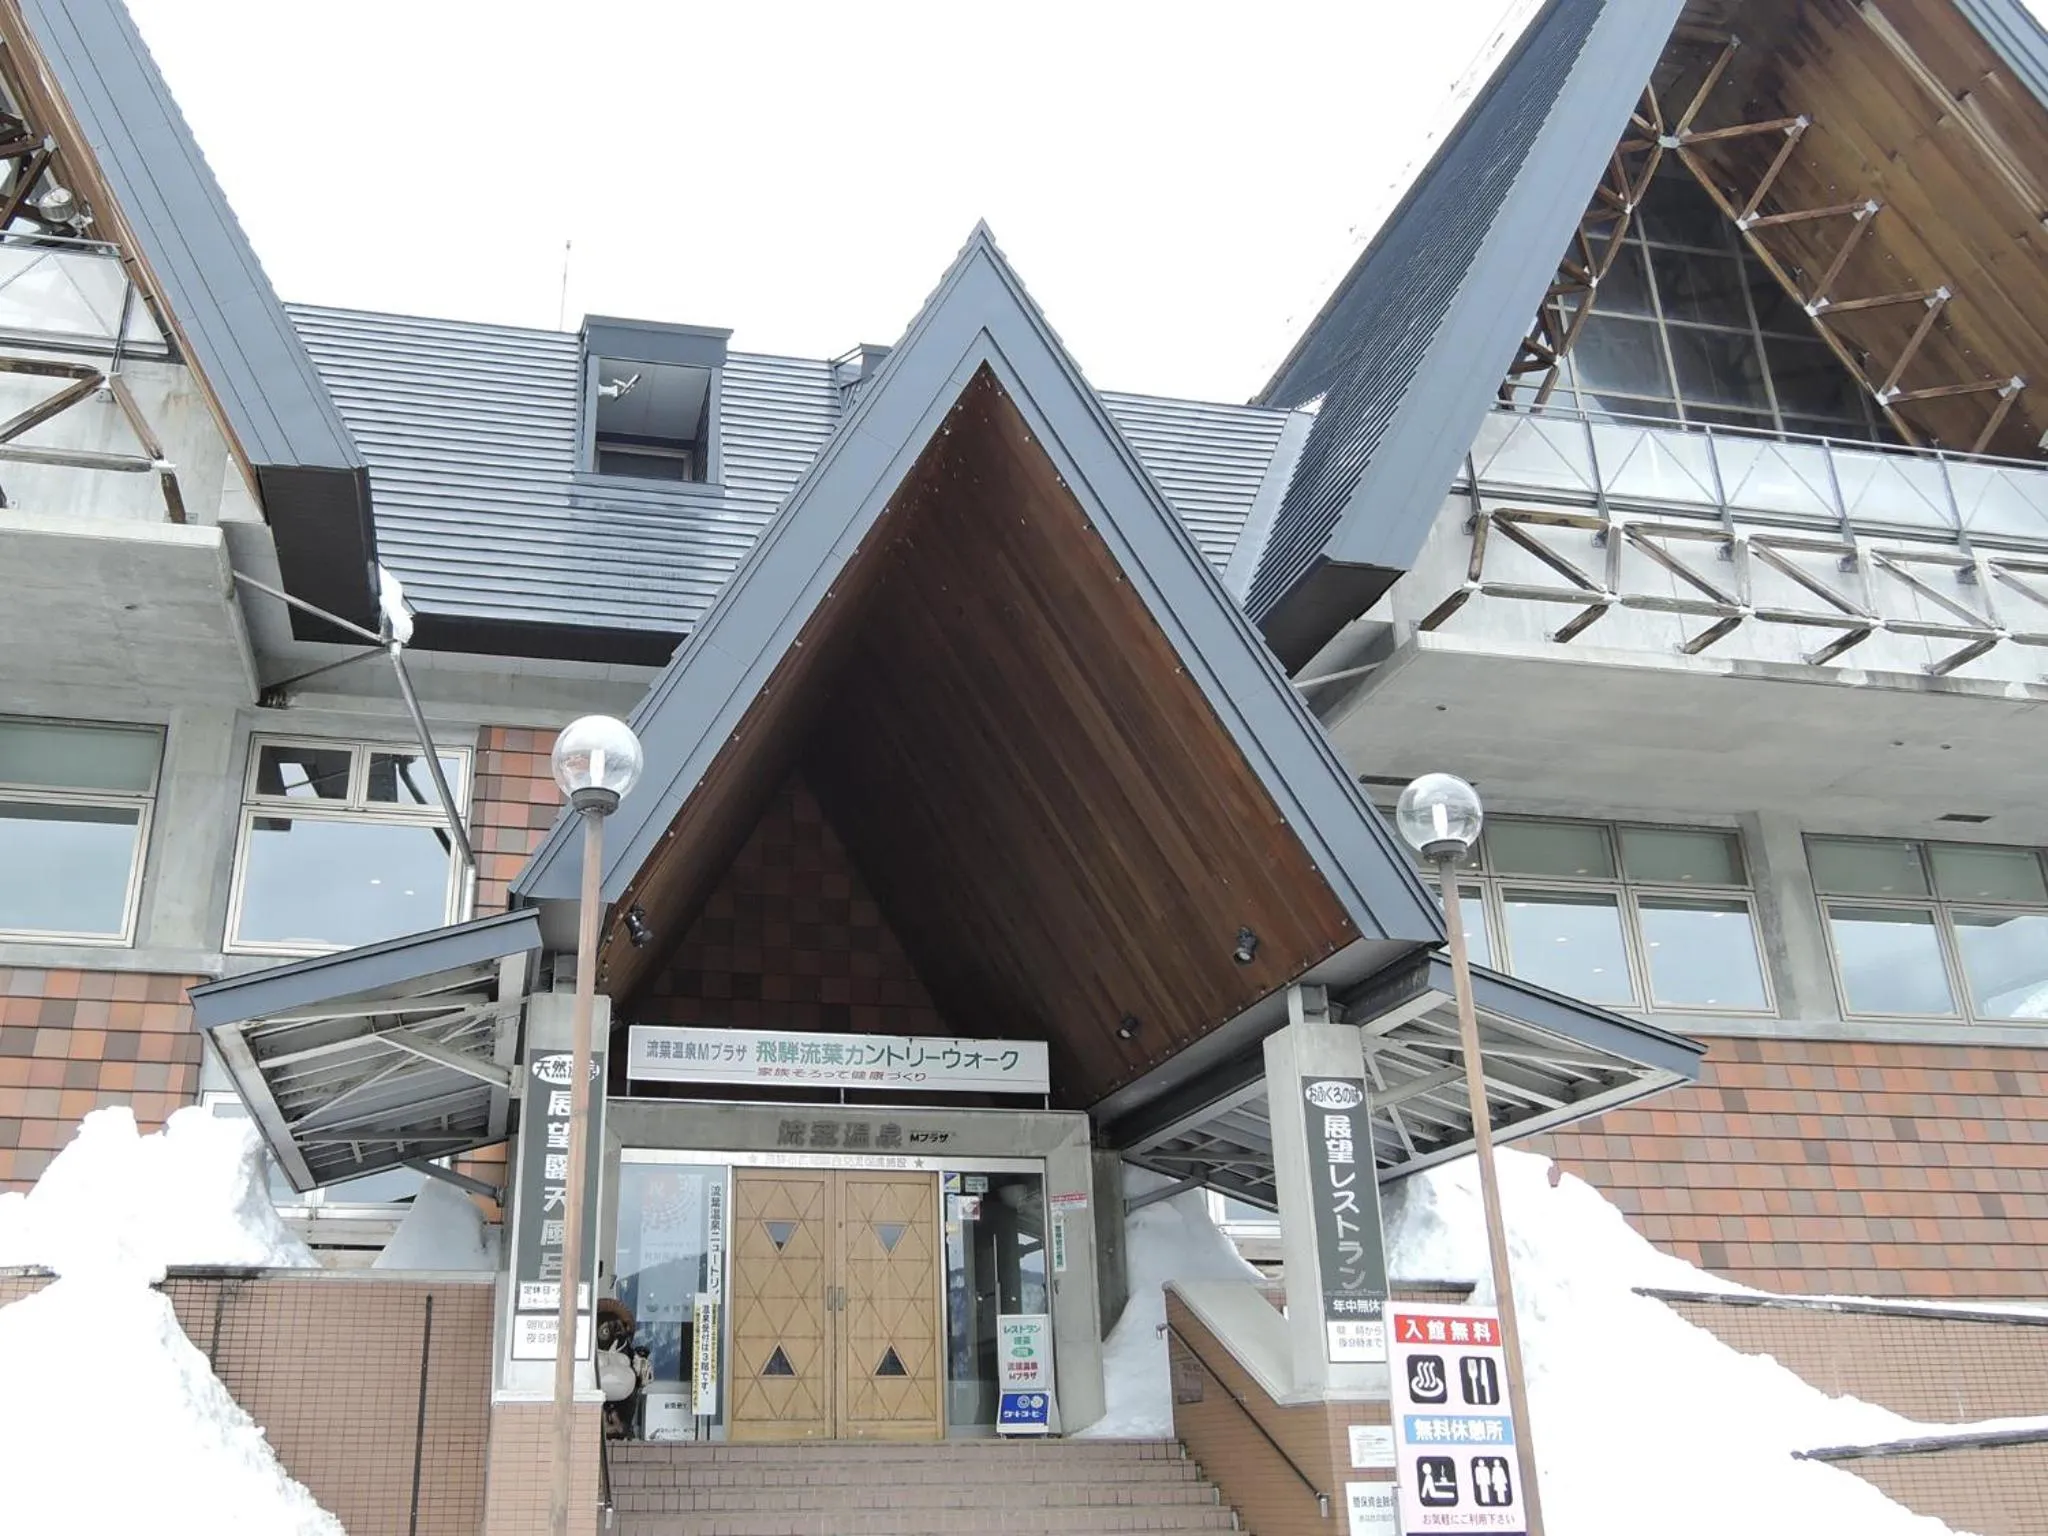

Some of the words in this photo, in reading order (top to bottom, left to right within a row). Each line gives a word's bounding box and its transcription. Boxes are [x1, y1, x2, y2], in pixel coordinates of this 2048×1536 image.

[646, 1039, 748, 1062] 流葉温泉Mプラザ
[757, 1067, 927, 1082] 家族そろって健康づくり
[777, 1119, 902, 1149] 流葉温泉
[910, 1132, 949, 1143] Mプラザ
[1324, 1115, 1366, 1290] 展望レストラン
[1333, 1299, 1381, 1313] 年中無休
[1004, 1325, 1041, 1334] レストラン
[1405, 1319, 1491, 1342] 入館無料
[1414, 1418, 1503, 1441] 無料休憩所
[1423, 1513, 1516, 1526] お気軽にご利用下さい
